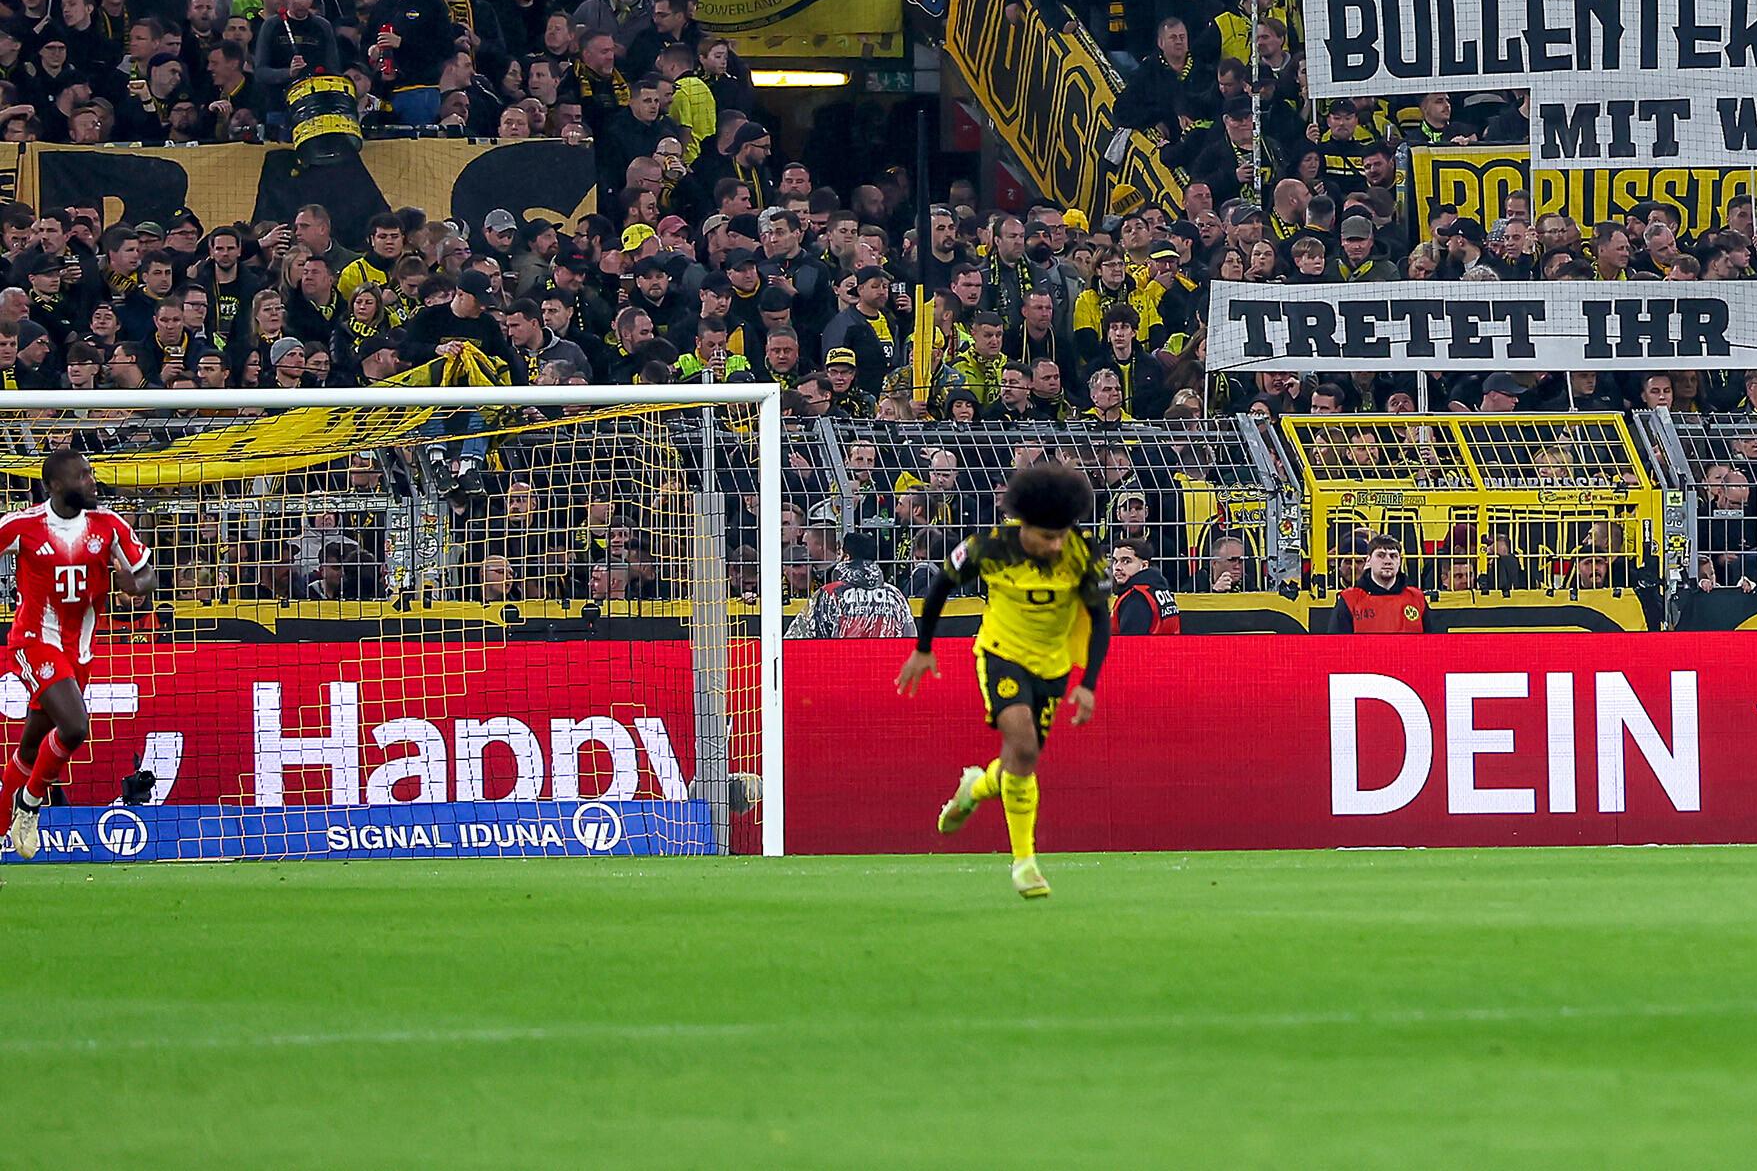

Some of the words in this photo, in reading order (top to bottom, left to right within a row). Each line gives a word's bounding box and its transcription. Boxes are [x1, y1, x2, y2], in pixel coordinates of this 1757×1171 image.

[1540, 97, 1690, 160] MIT
[1229, 300, 1546, 359] TRETET
[1583, 299, 1731, 359] IHR
[55, 565, 86, 603] T
[1329, 671, 1701, 816] DEIN
[328, 825, 453, 851] SIGNAL
[461, 823, 564, 849] IDUNA
